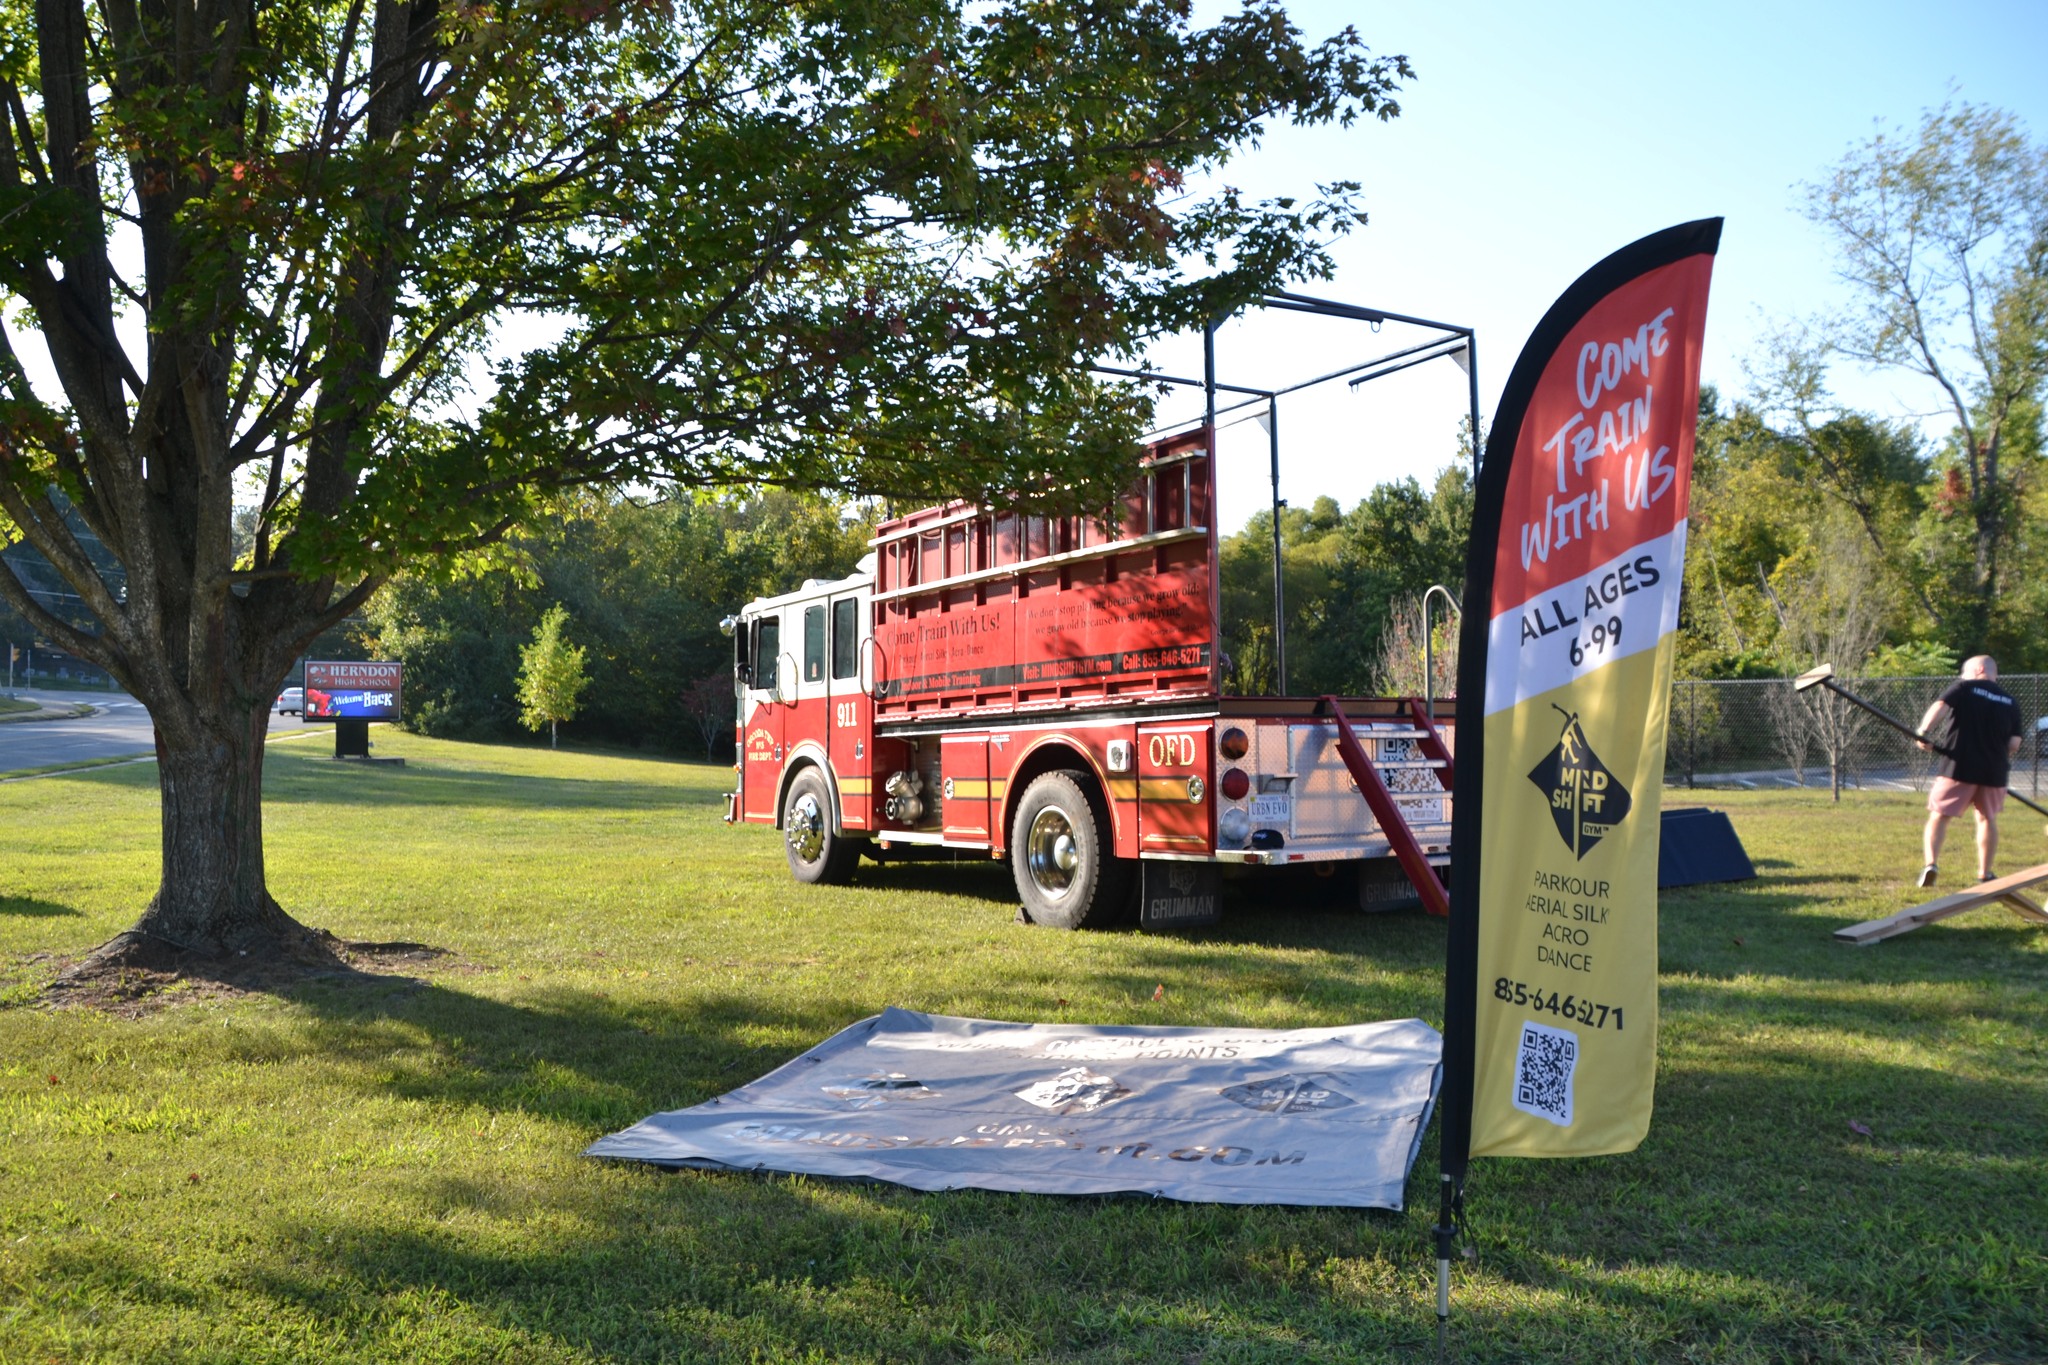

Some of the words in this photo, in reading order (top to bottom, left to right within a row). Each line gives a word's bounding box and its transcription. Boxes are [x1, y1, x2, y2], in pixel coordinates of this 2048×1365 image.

[1576, 307, 1674, 409] COME
[1542, 385, 1653, 492] TRAIN
[1520, 494, 1610, 572] WITH
[1623, 445, 1676, 512] US
[1520, 599, 1578, 646] ALL
[1583, 555, 1661, 620] AGES
[919, 620, 947, 642] Train
[950, 616, 977, 636] With
[981, 612, 1000, 632] Us!
[1568, 616, 1623, 668] 6-99
[330, 665, 397, 677] HERNDON
[1122, 653, 1141, 670] Call:
[837, 702, 857, 728] 911
[1149, 734, 1196, 767] OFD
[1272, 801, 1288, 815] EVO
[1533, 870, 1610, 899] PARKOUR
[1151, 895, 1214, 920] GRUMMAN
[1525, 893, 1569, 919] AERIAL
[1542, 922, 1589, 946] ACRO
[1537, 945, 1593, 972] DANCE
